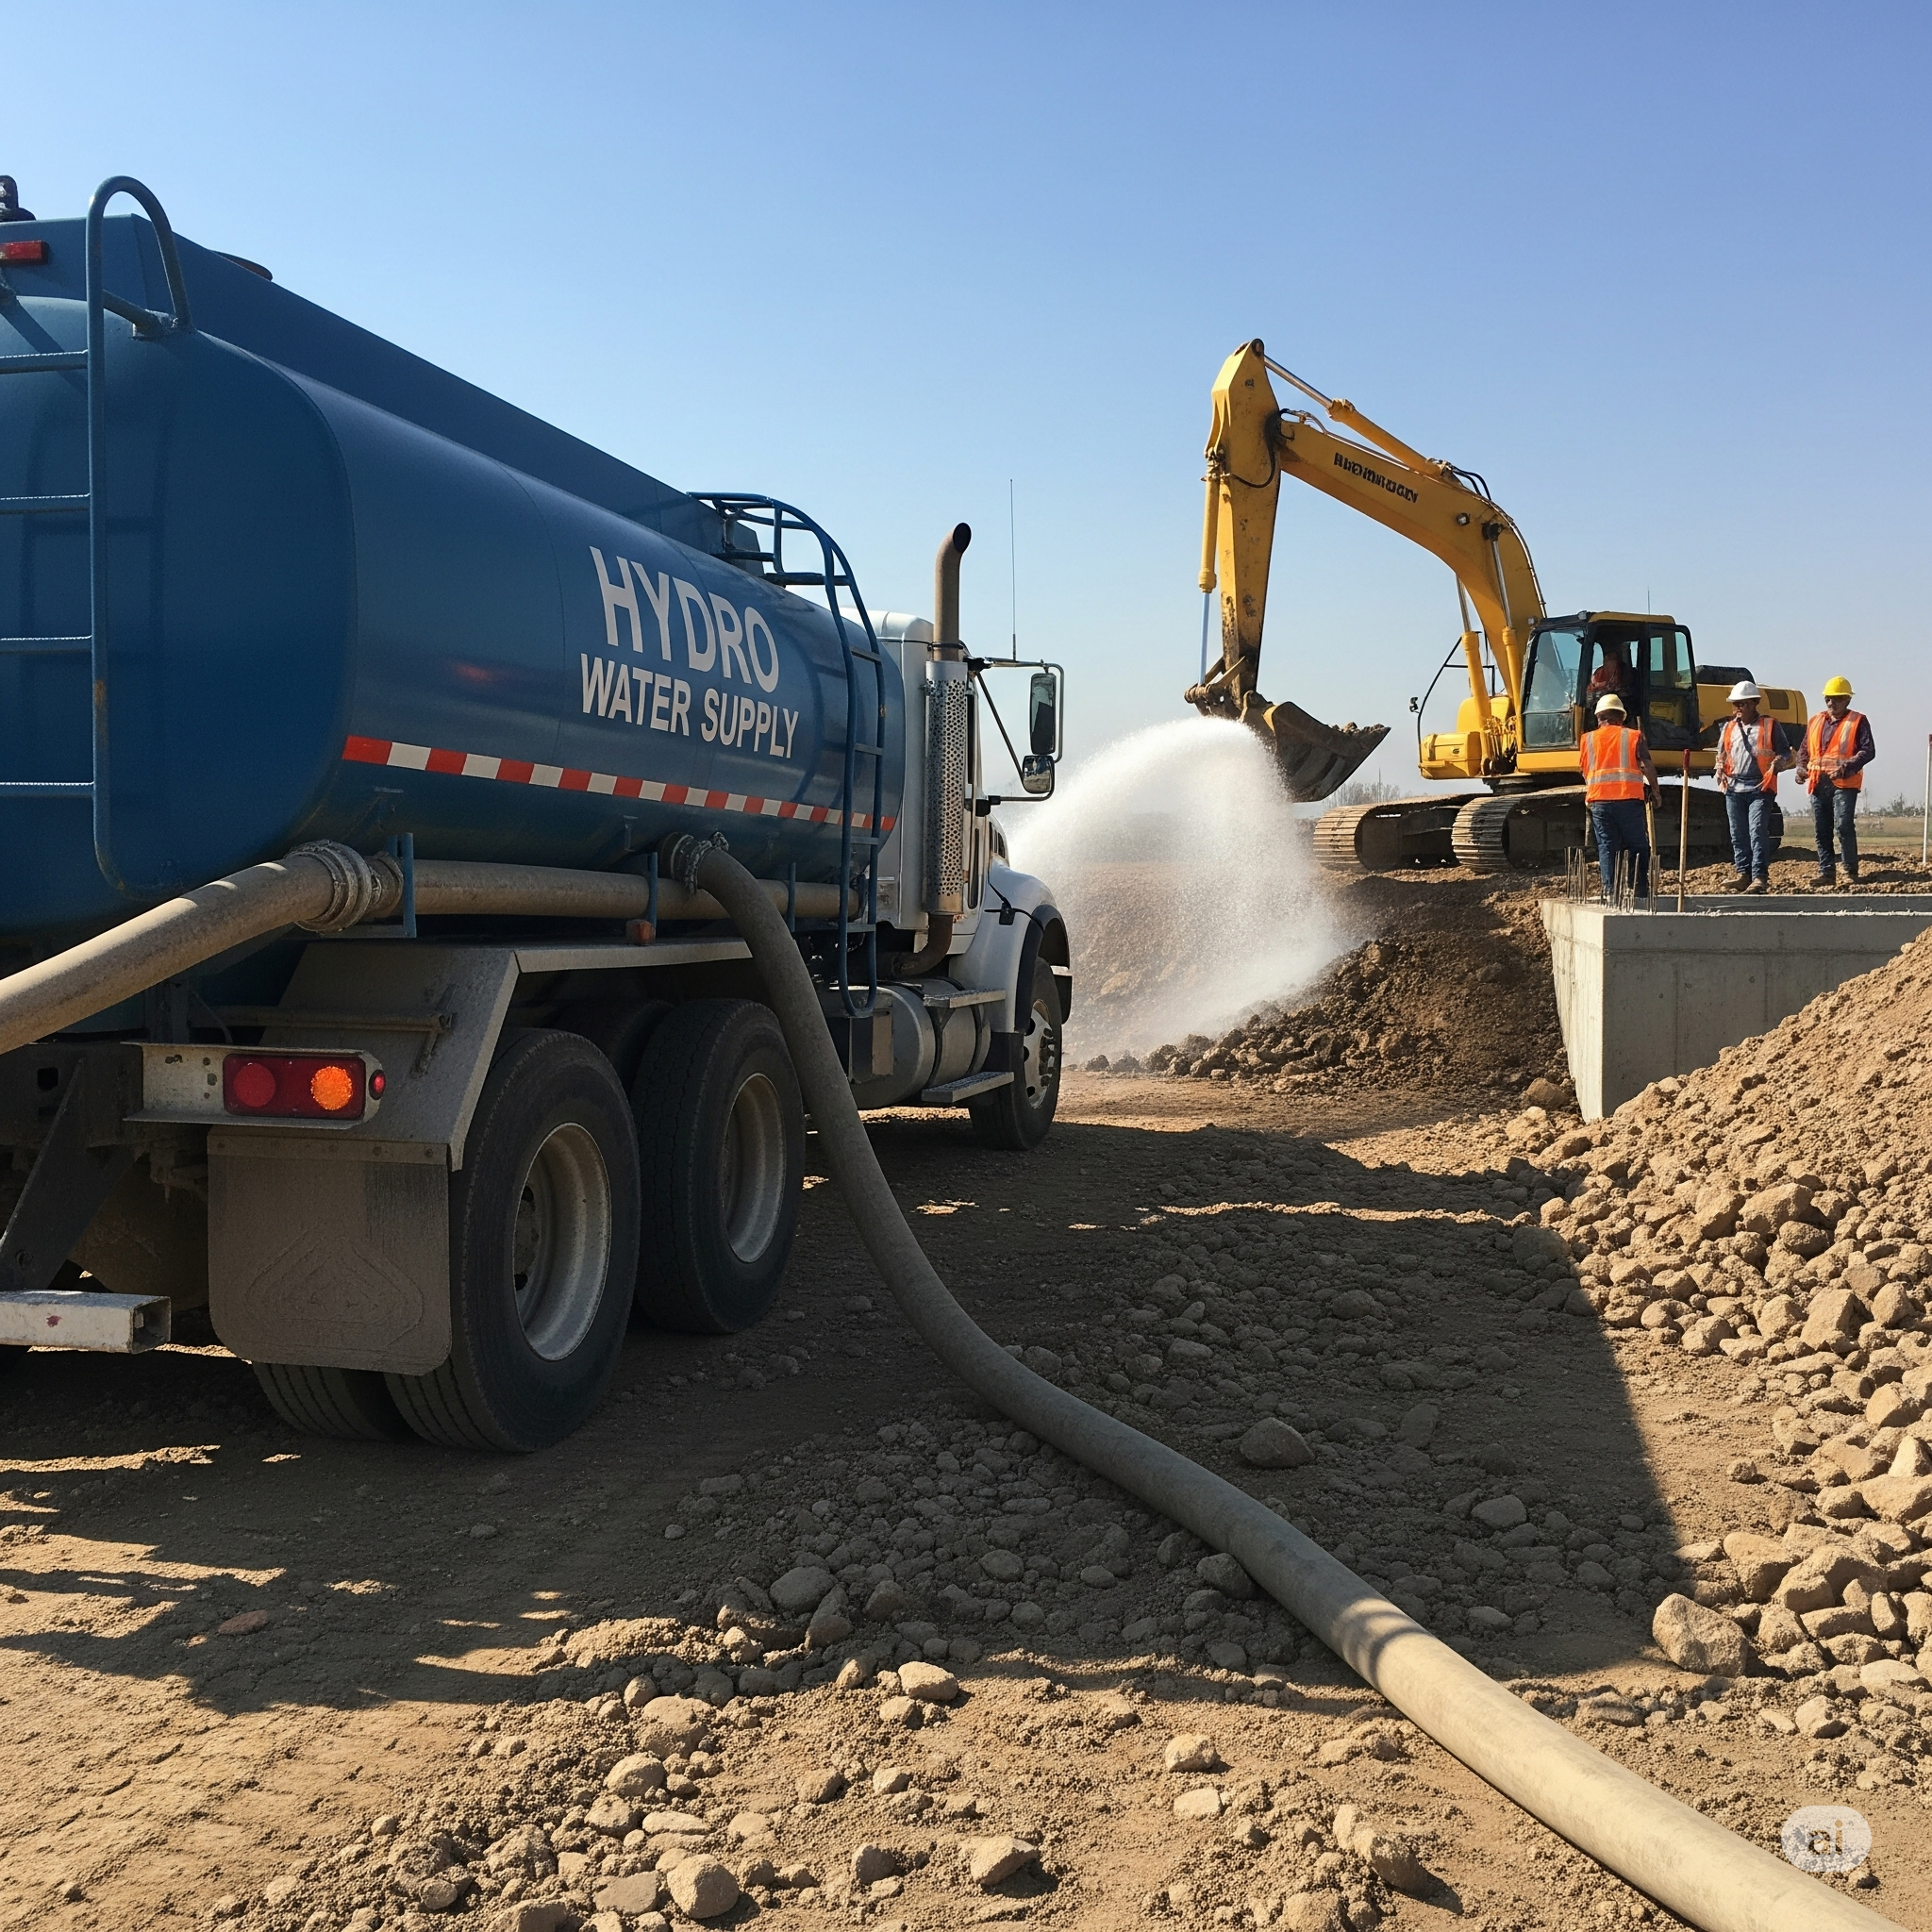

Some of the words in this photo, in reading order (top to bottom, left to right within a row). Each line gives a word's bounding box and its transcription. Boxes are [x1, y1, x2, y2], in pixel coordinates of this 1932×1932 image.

[589, 545, 779, 693] HYDRO
[580, 653, 691, 737] WATER
[701, 688, 799, 758] SUPPLY
